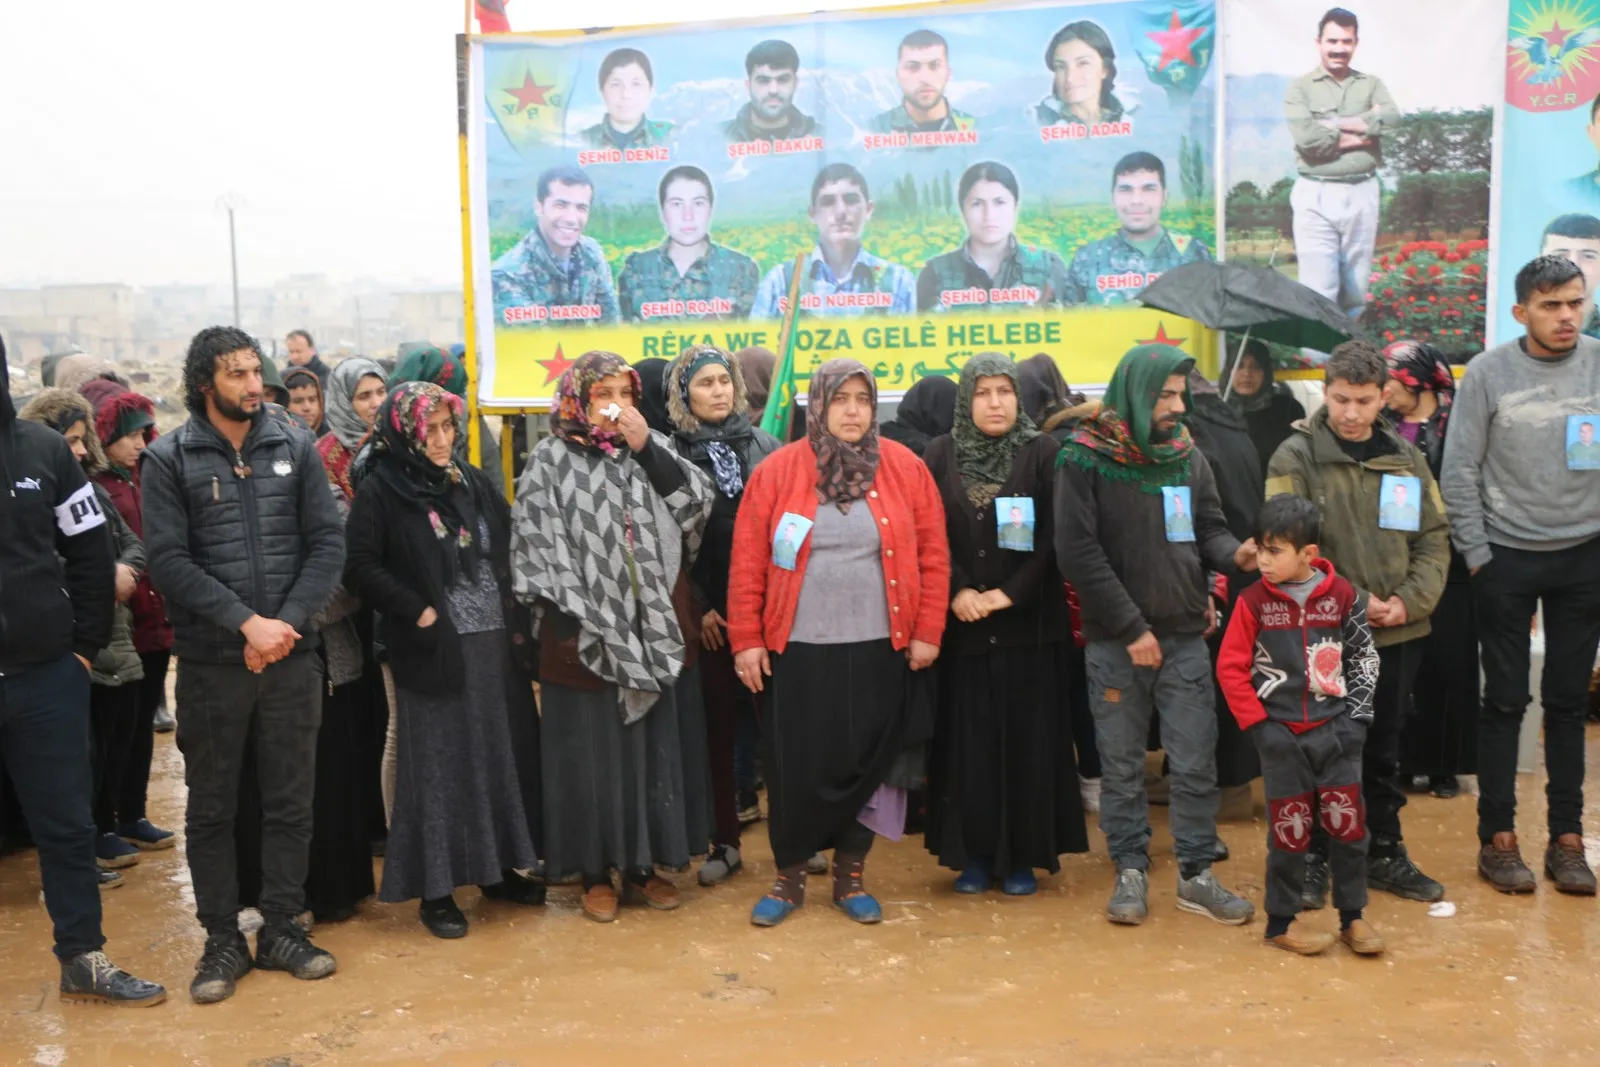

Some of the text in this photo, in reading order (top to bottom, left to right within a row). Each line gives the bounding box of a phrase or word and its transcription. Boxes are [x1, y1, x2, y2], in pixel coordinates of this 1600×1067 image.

[1529, 92, 1577, 107] Y.C.R
[1091, 122, 1131, 136] ADAR
[911, 131, 977, 145] MERWAN
[551, 304, 600, 318] HARON
[777, 328, 852, 352] OZA
[862, 321, 936, 349] GELÊ
[947, 322, 1061, 347] HELEBE
[1261, 601, 1289, 613] MAN
